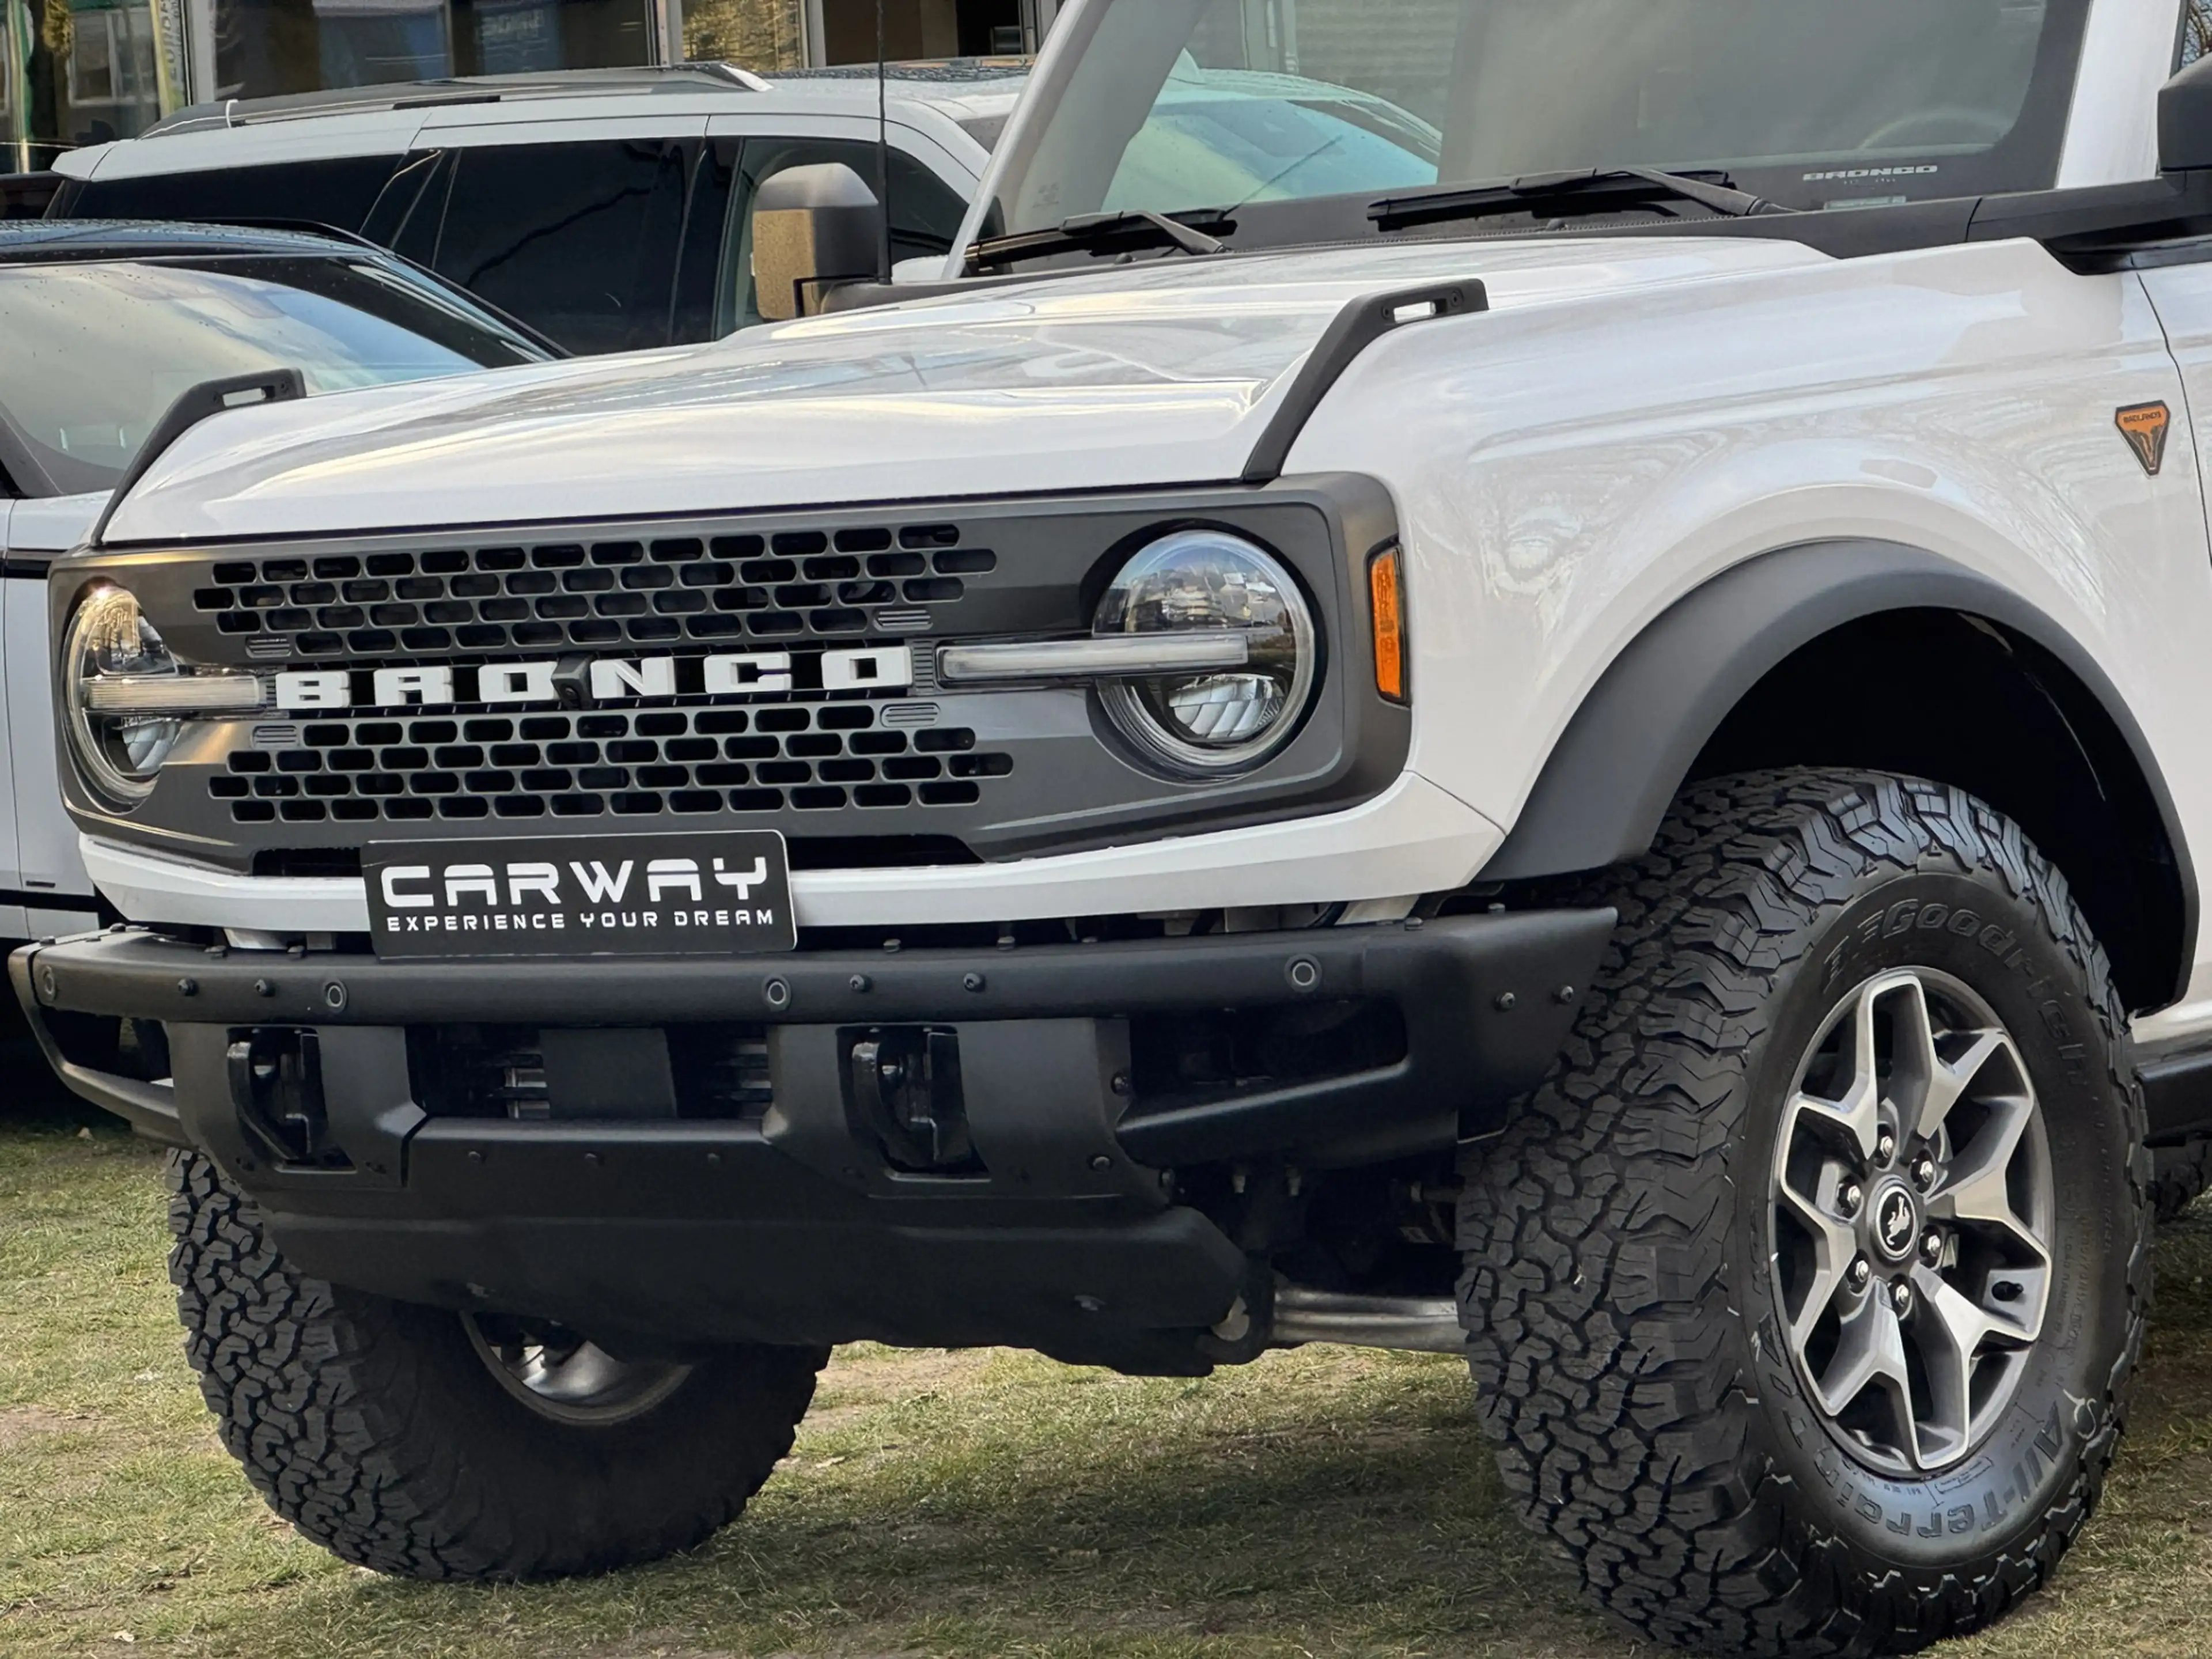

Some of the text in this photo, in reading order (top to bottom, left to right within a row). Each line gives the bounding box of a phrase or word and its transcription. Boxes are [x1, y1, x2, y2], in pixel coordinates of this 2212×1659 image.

[1802, 165, 1938, 181] BRONCO
[276, 646, 912, 710] BRONCO
[380, 857, 767, 908] CARWAY
[387, 909, 774, 931] EXPERIENCE YOUR DREAM
